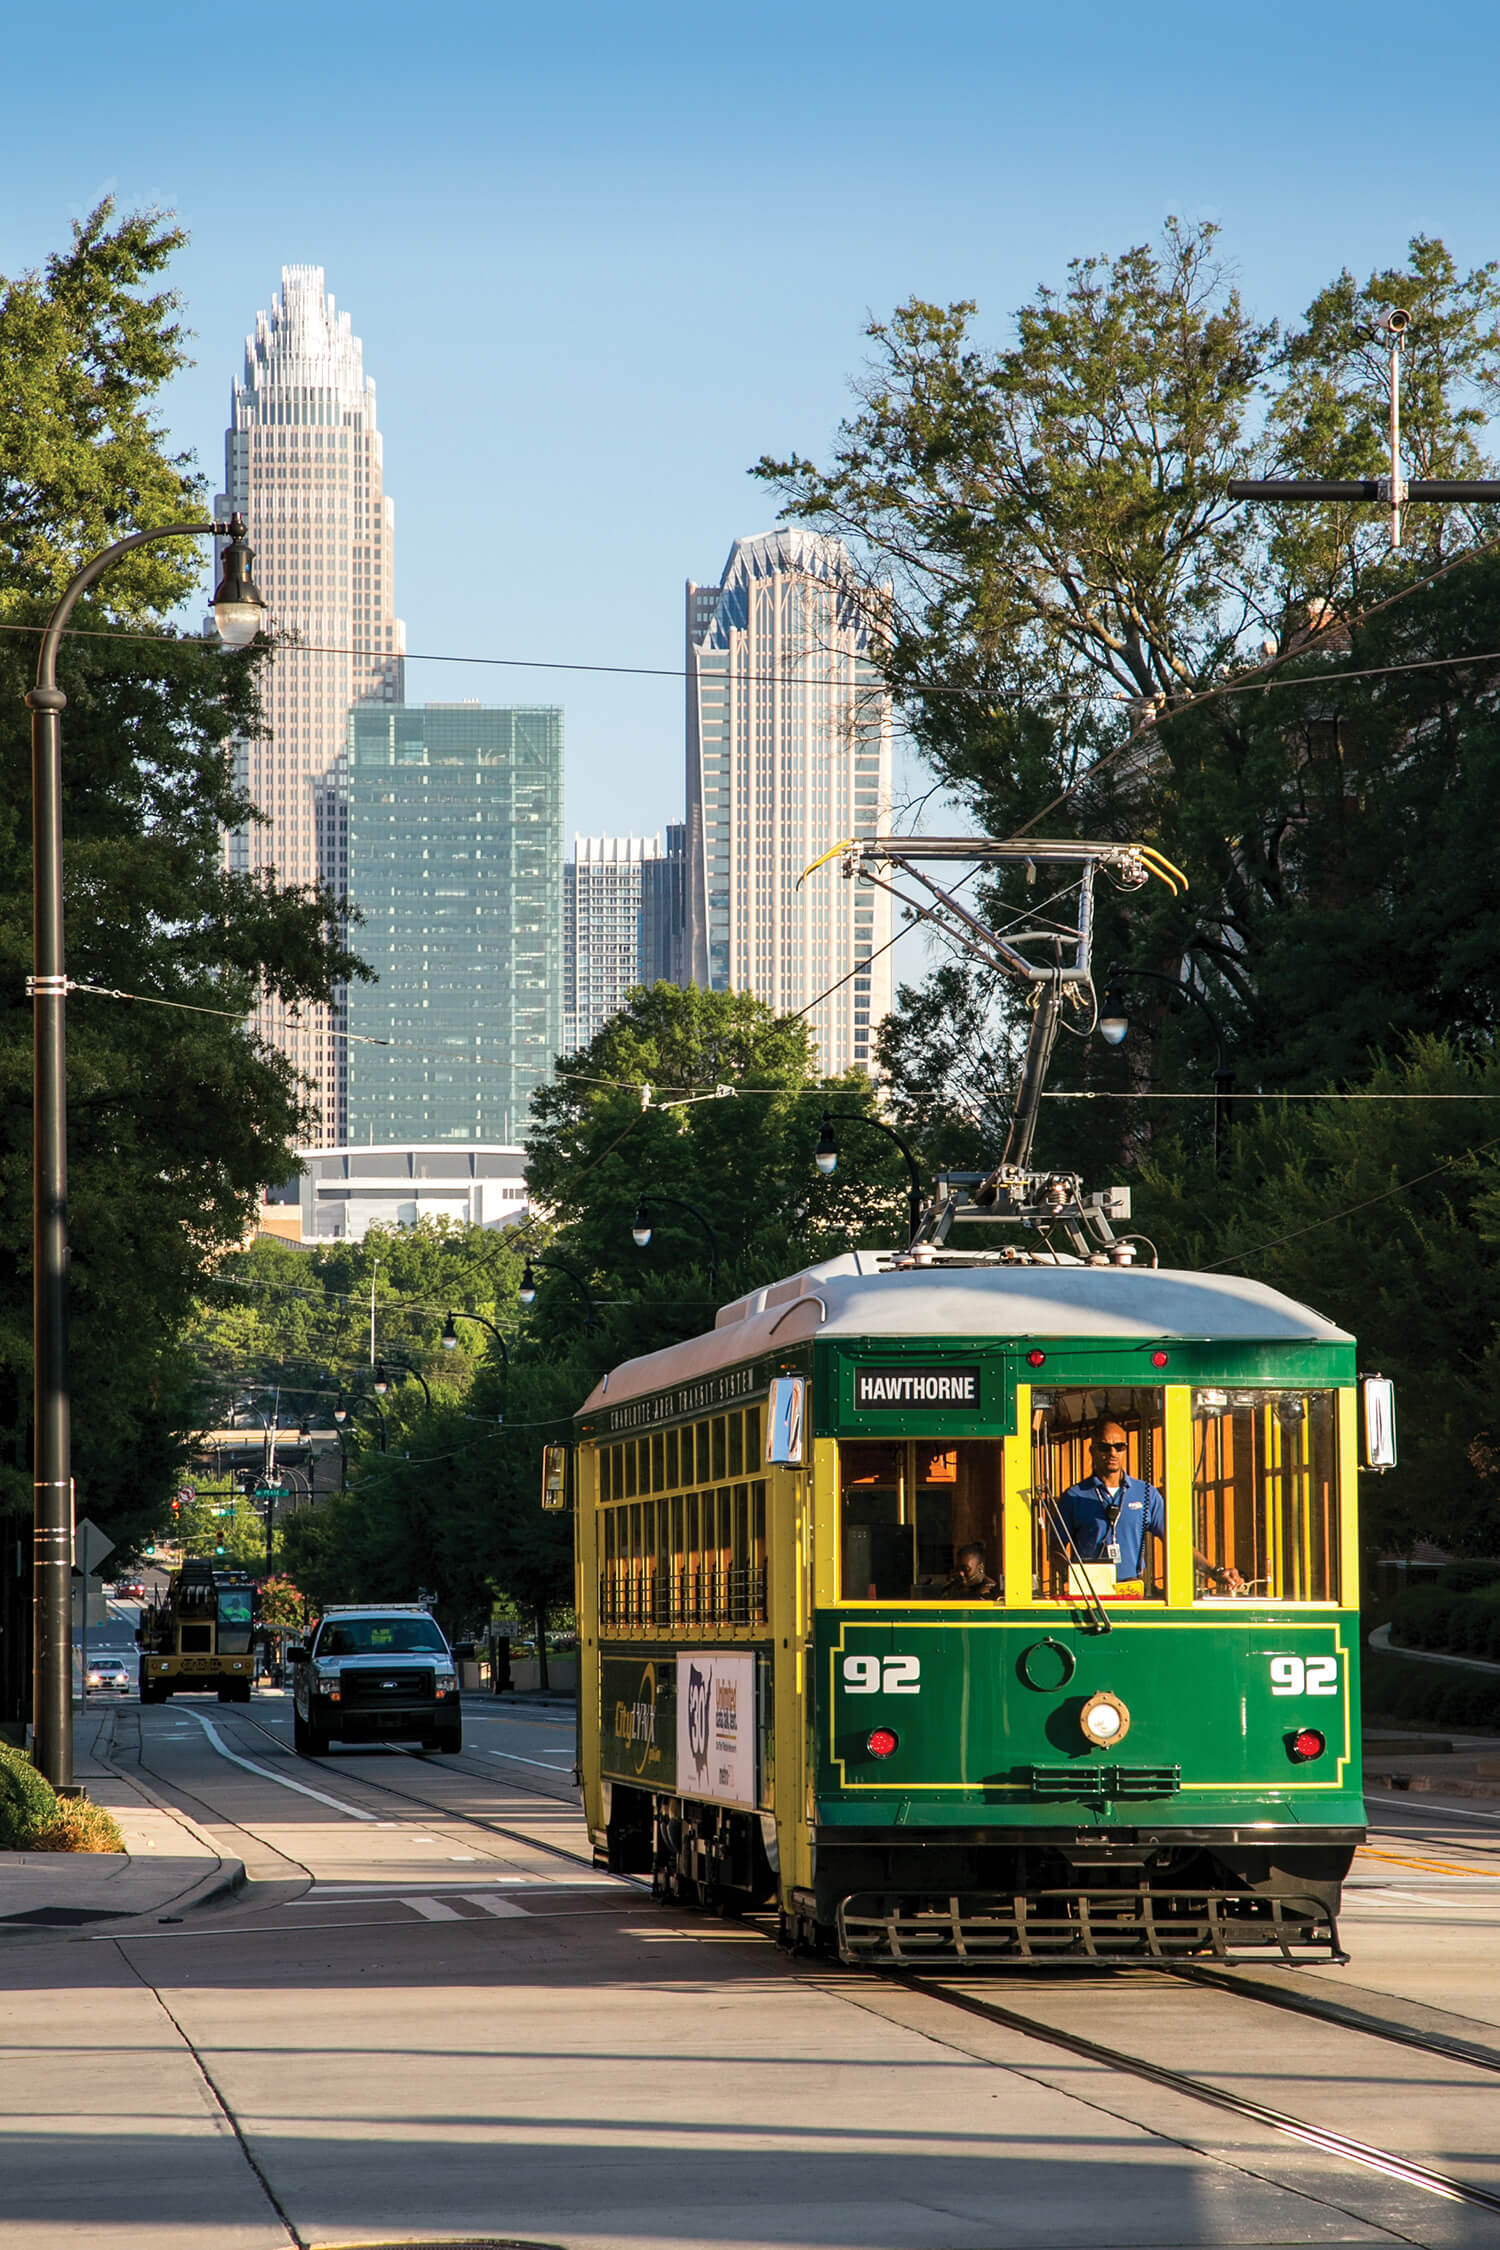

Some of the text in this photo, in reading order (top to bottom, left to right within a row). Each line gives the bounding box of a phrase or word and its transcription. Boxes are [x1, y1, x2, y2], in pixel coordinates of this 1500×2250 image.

[610, 1368, 754, 1431] CHARLOTTE AREA TRANSIT SYSTEM
[861, 1377, 975, 1400] HAWTHORNE
[843, 1656, 920, 1694] 92
[1270, 1656, 1337, 1695] 92
